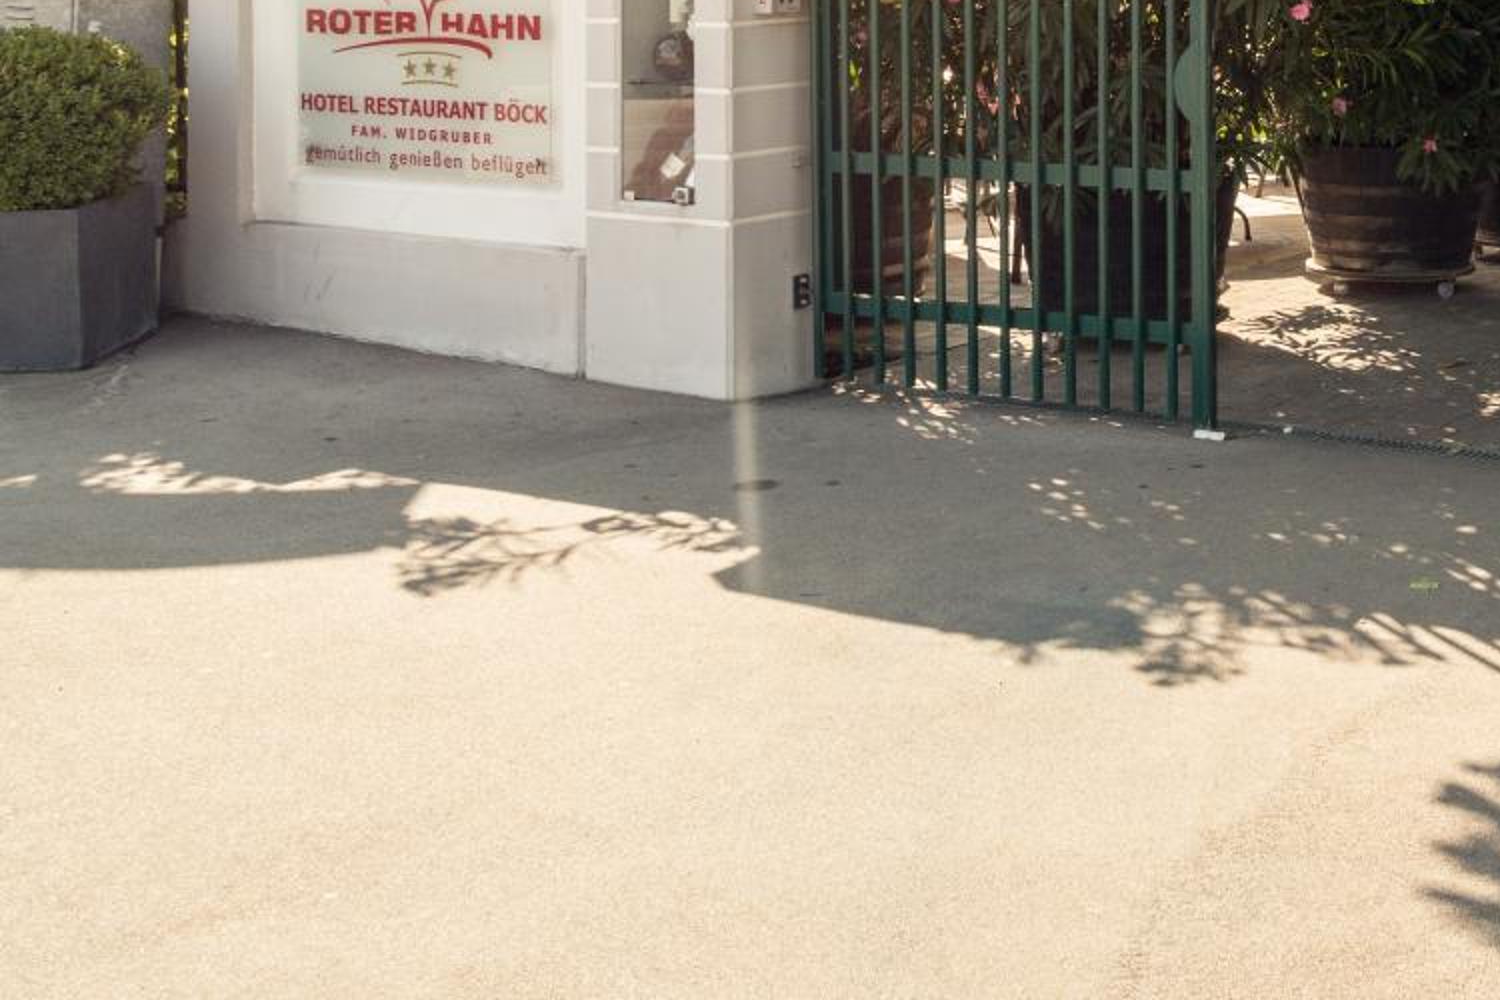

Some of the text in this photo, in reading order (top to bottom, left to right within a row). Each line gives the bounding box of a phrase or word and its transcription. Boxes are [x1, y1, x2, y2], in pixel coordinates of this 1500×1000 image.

[305, 8, 542, 41] ROTER HAHN
[300, 92, 548, 125] HOTEL RESTAURANT BÖCK
[351, 124, 494, 145] FAM. WIDGRUBER
[305, 143, 382, 164] gemütlich
[389, 151, 463, 170] genießen
